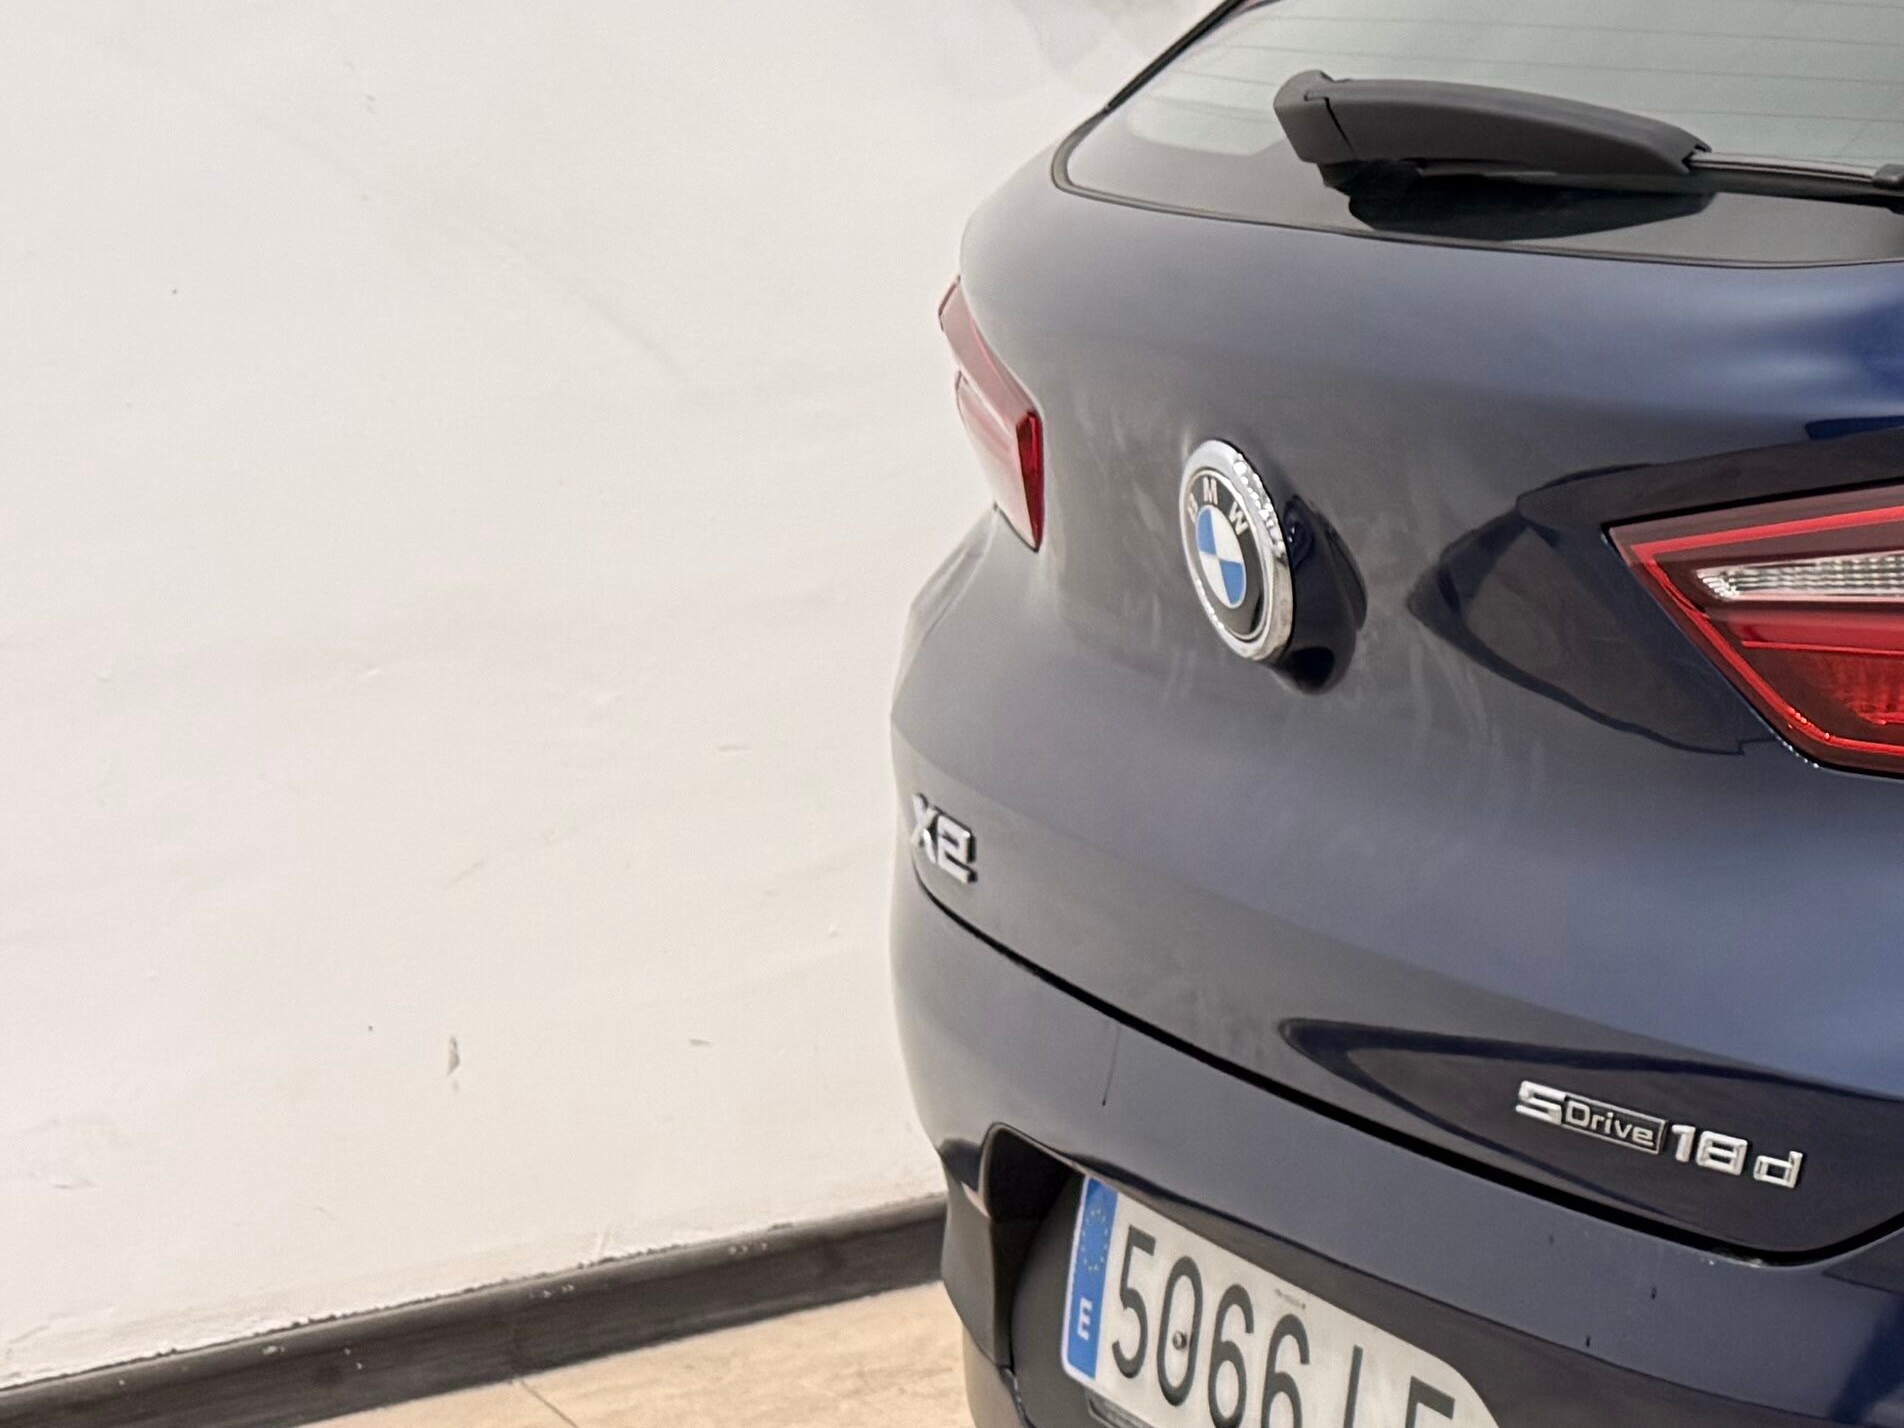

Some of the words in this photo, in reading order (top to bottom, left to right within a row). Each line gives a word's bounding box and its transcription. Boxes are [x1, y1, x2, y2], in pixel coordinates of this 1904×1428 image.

[1186, 475, 1250, 536] BMW
[911, 793, 977, 885] X2
[1075, 1296, 1094, 1343] E
